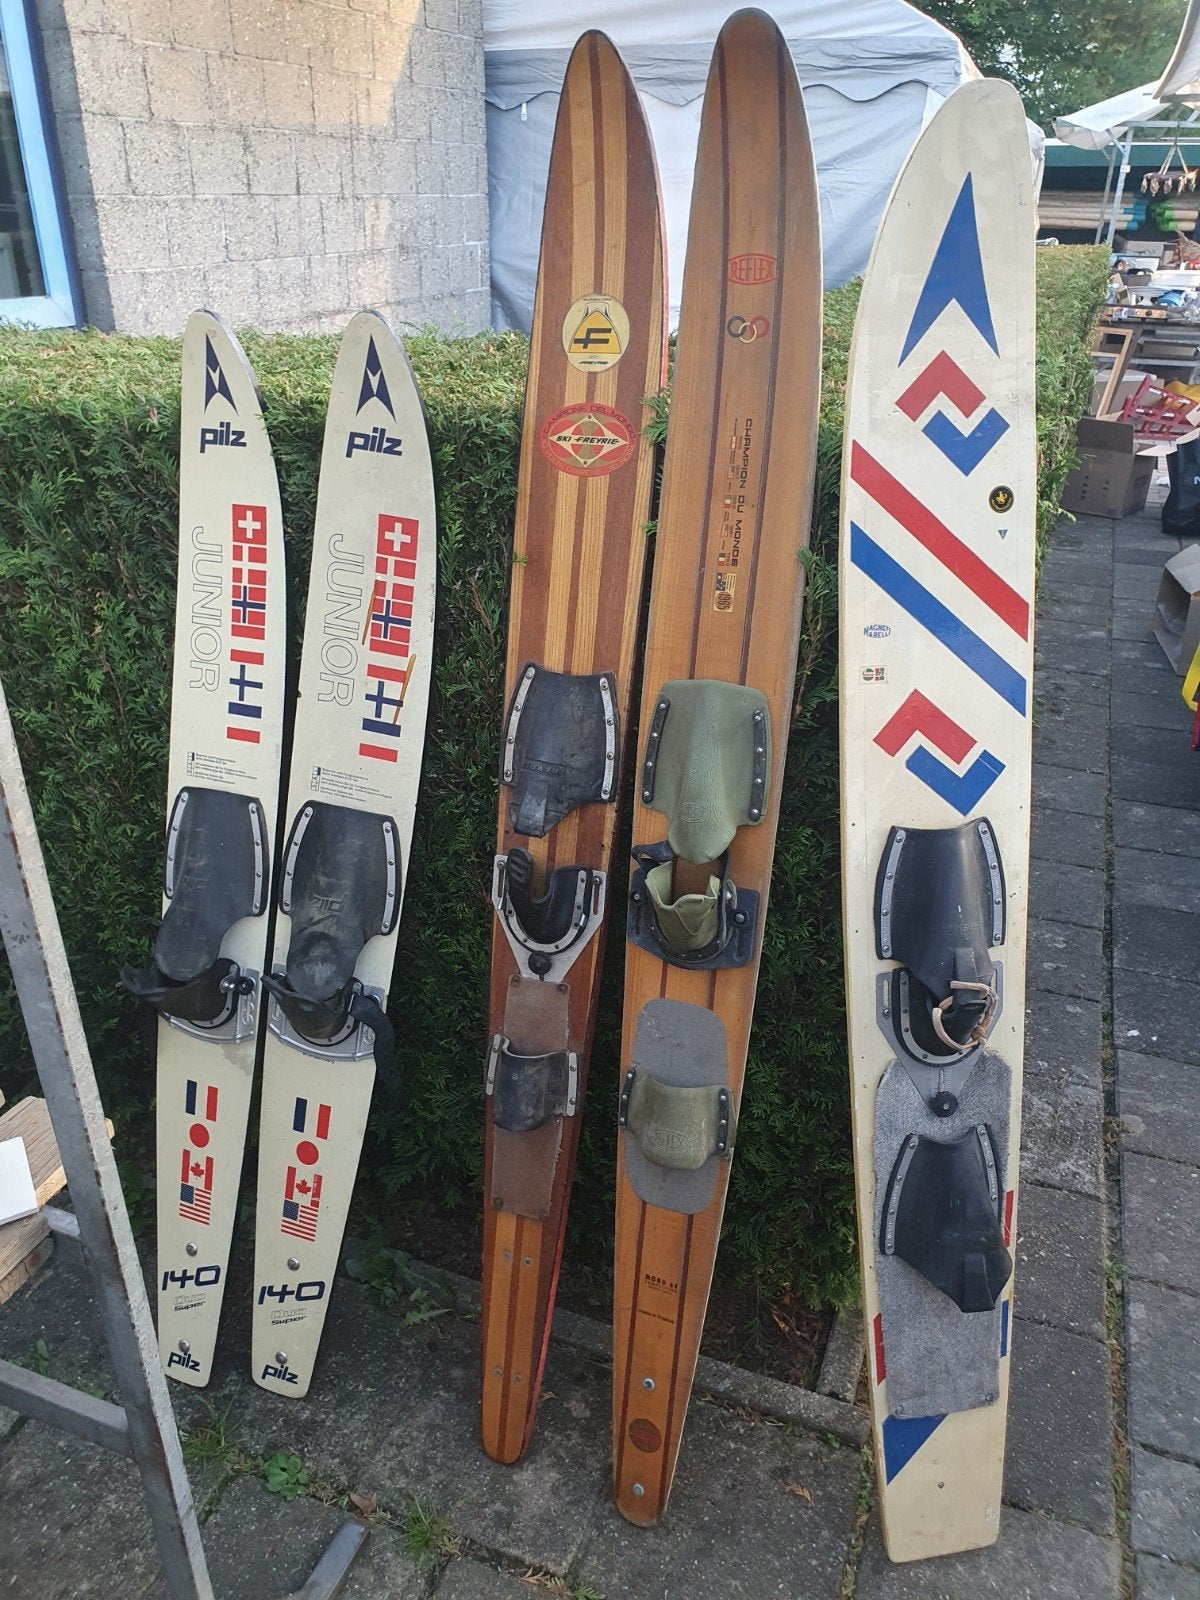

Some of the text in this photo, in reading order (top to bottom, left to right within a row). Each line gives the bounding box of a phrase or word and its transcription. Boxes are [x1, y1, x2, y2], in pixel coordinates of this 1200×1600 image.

[543, 405, 636, 439] CAMPIONE DEL MONDO
[199, 421, 247, 454] pilz
[345, 427, 403, 458] pilz
[574, 436, 620, 445] FREYRIE
[740, 418, 752, 488] CHAMPION
[737, 495, 745, 513] DU
[731, 520, 742, 567] MONDE
[189, 525, 223, 692] JUNIOR
[717, 591, 731, 610] 1965
[317, 533, 365, 707] JUNIOR
[161, 1264, 221, 1291] 140
[257, 1280, 326, 1305] 140
[174, 1301, 206, 1311] Super
[271, 1315, 307, 1325] Super
[167, 1351, 201, 1373] pilz
[261, 1364, 298, 1384] pilz
